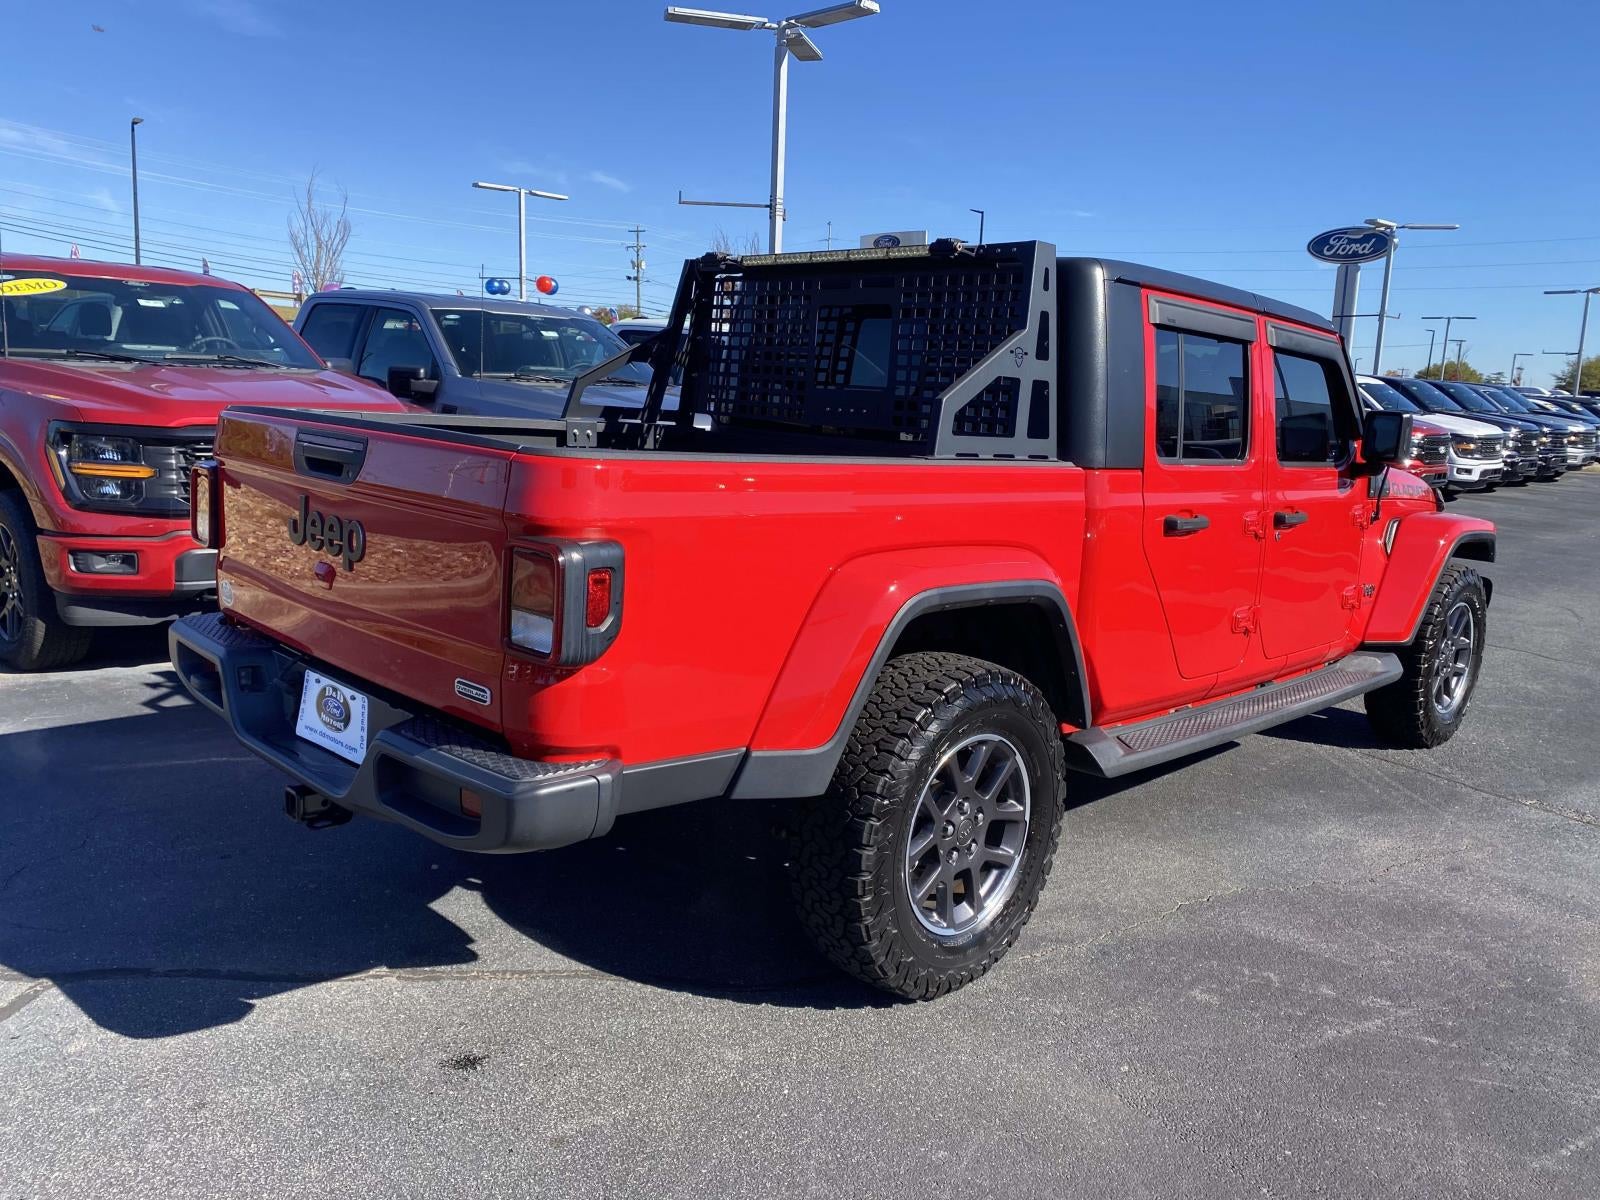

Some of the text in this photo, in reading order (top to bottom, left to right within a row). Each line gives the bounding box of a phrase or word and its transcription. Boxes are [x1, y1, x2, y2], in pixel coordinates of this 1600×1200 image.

[1323, 234, 1377, 256] Ford
[0, 281, 58, 293] DEMO
[287, 494, 366, 572] Jeep
[325, 686, 344, 703] D&D
[456, 684, 488, 700] OVERLAND
[326, 700, 342, 717] Ford
[320, 712, 345, 730] MOTORS
